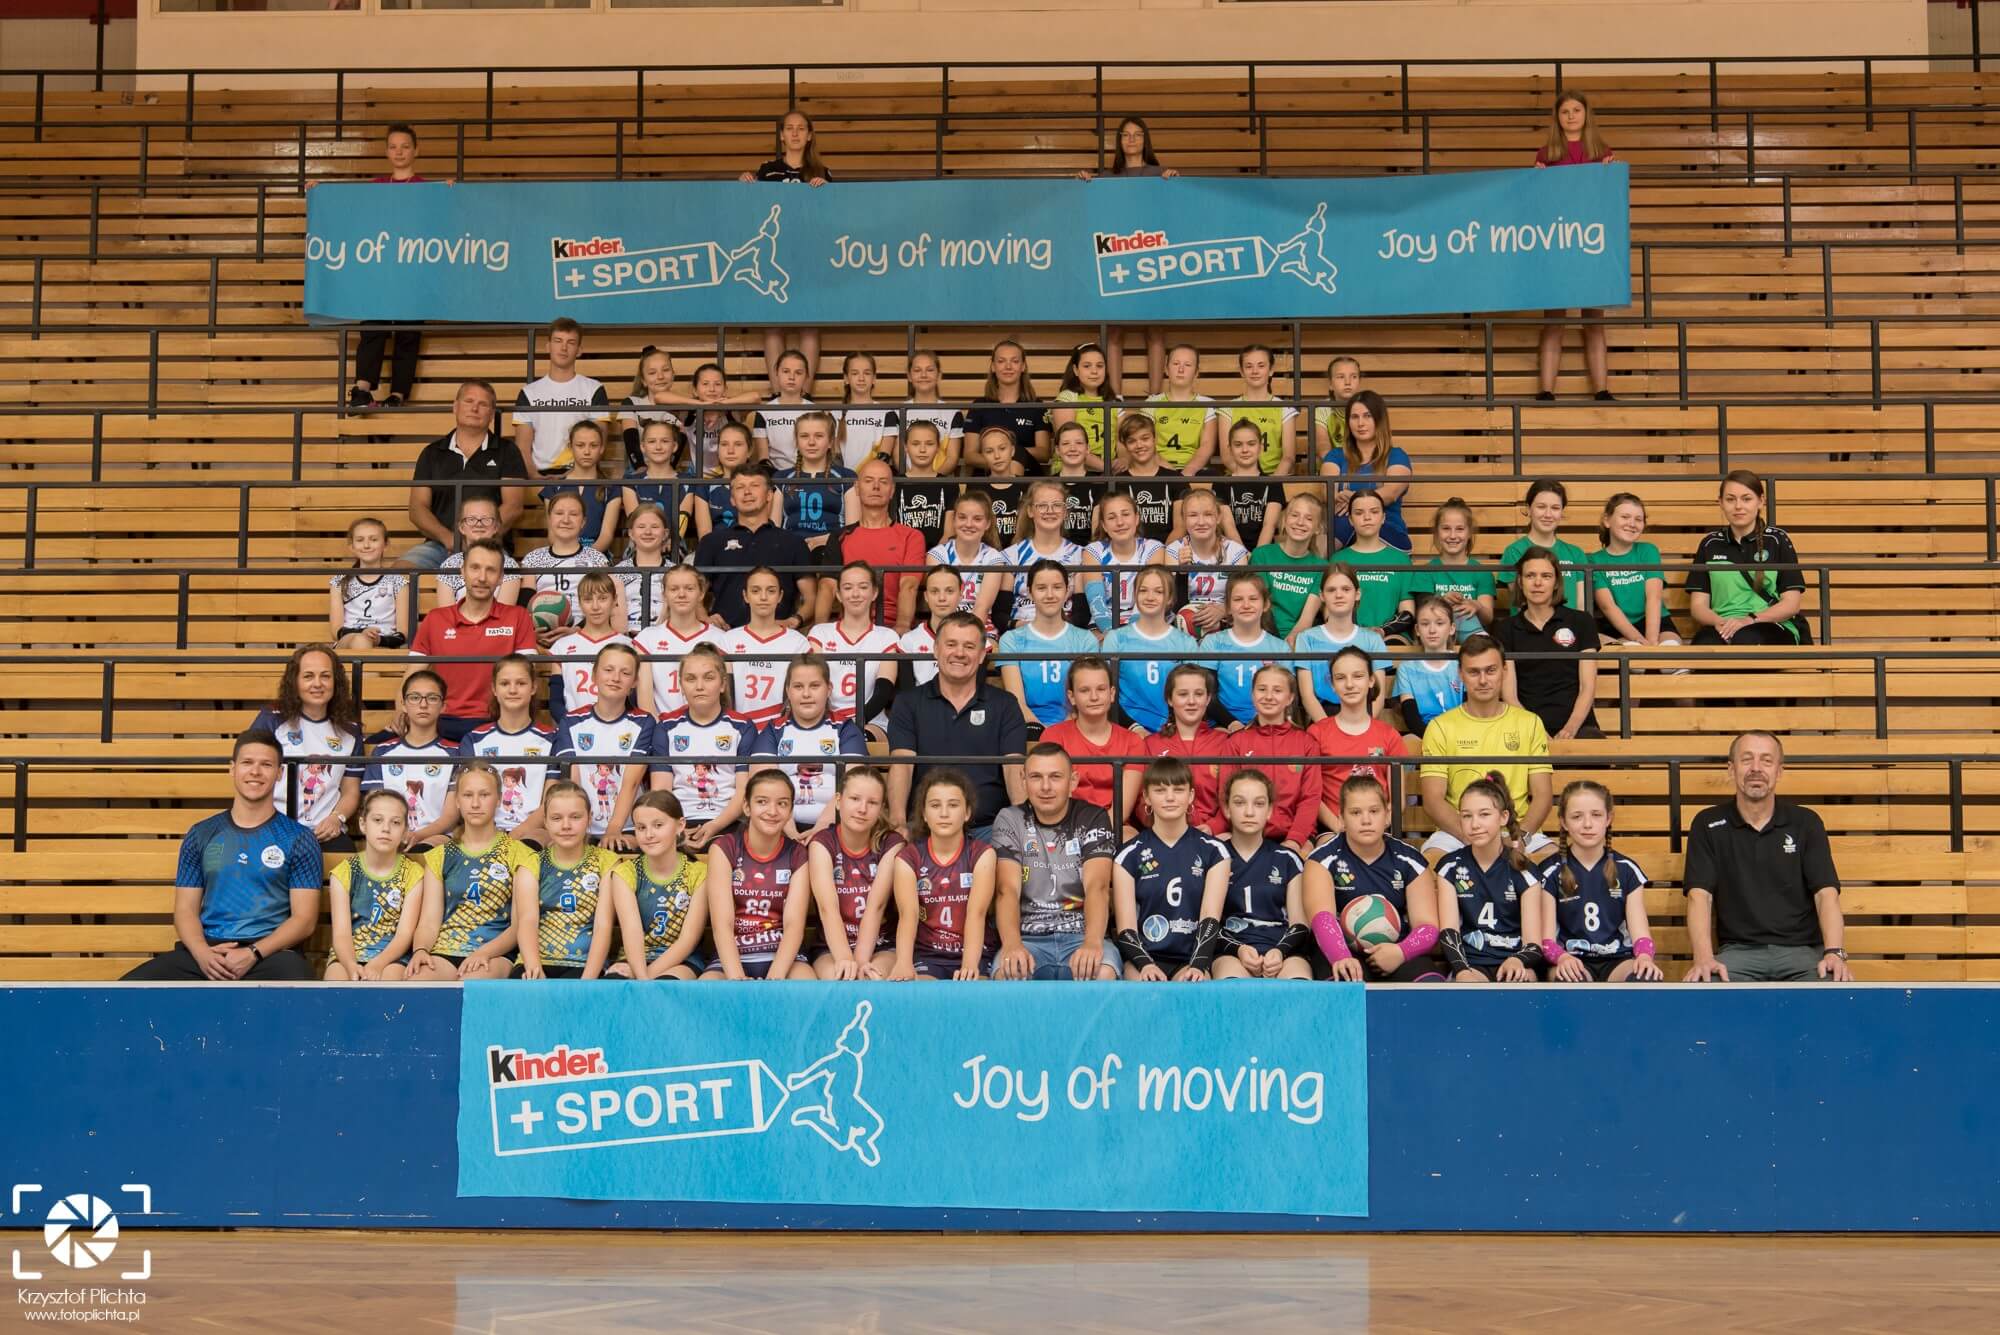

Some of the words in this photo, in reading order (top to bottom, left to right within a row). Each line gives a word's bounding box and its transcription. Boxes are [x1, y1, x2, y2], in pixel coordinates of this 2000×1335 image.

[305, 232, 346, 270] oy
[356, 231, 390, 264] of
[397, 232, 510, 271] moving
[1378, 228, 1438, 263] Joy
[1447, 221, 1480, 254] of
[1490, 216, 1605, 254] moving
[830, 235, 889, 276] Joy
[898, 233, 932, 267] of
[940, 233, 1052, 270] moving
[1136, 246, 1245, 284] SPORT
[592, 253, 699, 288] SPORT
[847, 417, 883, 427] chniSat
[1166, 433, 1182, 451] 4
[799, 491, 823, 521] 10
[363, 599, 372, 618] 2
[841, 673, 857, 697] 6
[1040, 661, 1062, 684] 13
[1147, 660, 1160, 684] 6
[744, 674, 776, 701] 37
[465, 882, 480, 906] 4
[560, 892, 577, 914] 9
[734, 888, 759, 896] DOLNY
[1166, 876, 1182, 907] 6
[1243, 885, 1253, 914] 1
[854, 896, 867, 919] 2
[940, 906, 953, 928] 4
[1477, 902, 1498, 930] 4
[1583, 902, 1600, 932] 8
[653, 910, 668, 936] 3
[953, 1054, 1049, 1122] Joy
[1067, 1053, 1123, 1110] of
[1138, 1056, 1325, 1125] moving
[555, 1078, 733, 1135] SPORT
